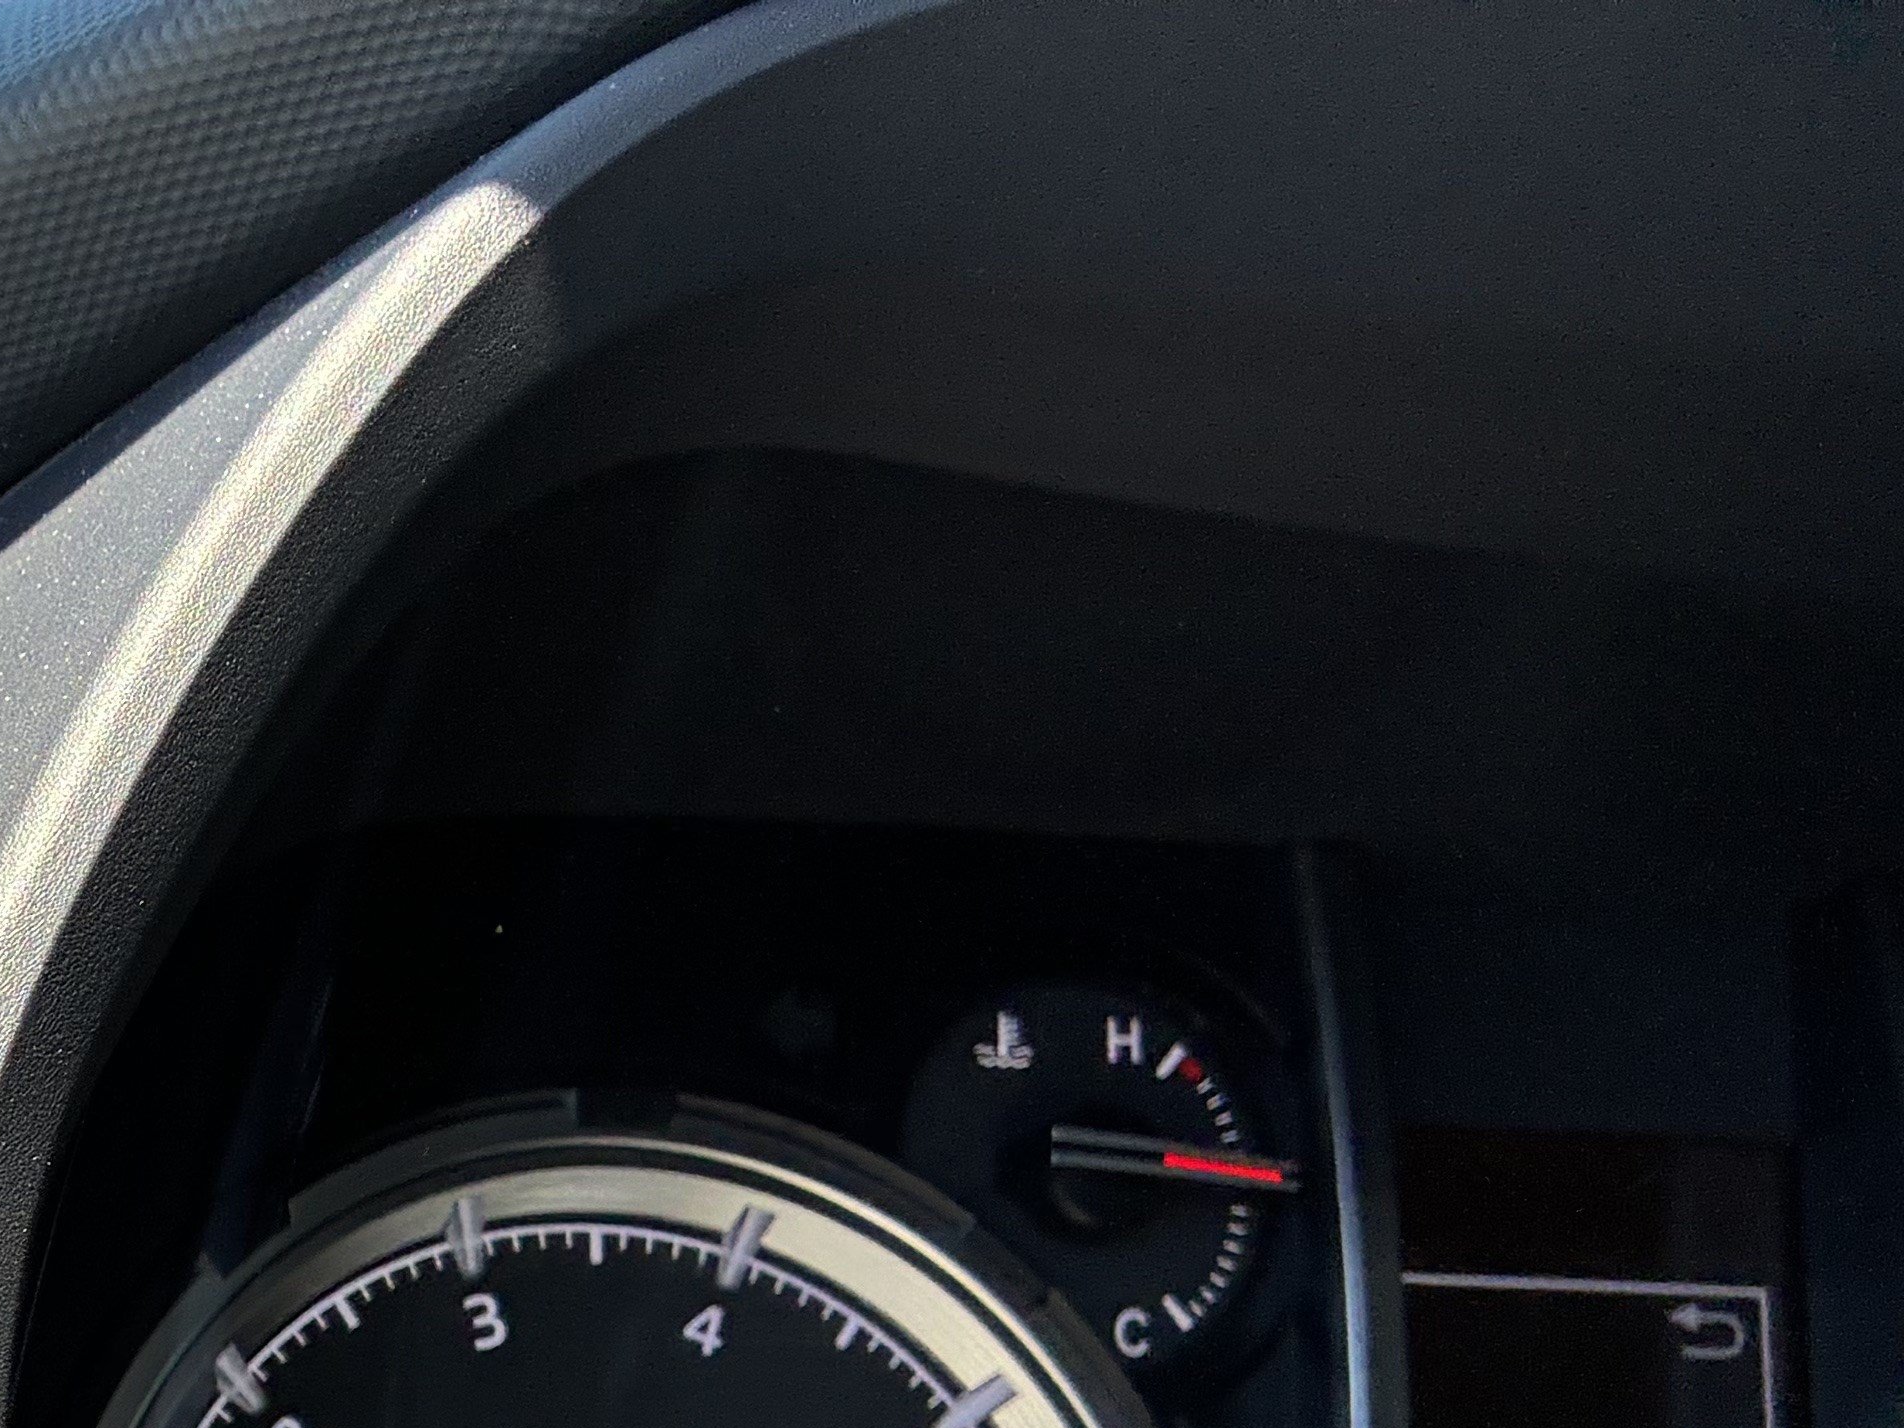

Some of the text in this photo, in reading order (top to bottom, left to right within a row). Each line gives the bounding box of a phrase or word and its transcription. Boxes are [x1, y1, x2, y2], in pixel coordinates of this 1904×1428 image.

[1106, 1015, 1142, 1065] H
[462, 1293, 509, 1351] 3
[682, 1304, 726, 1357] 4
[1114, 1306, 1151, 1359] C
